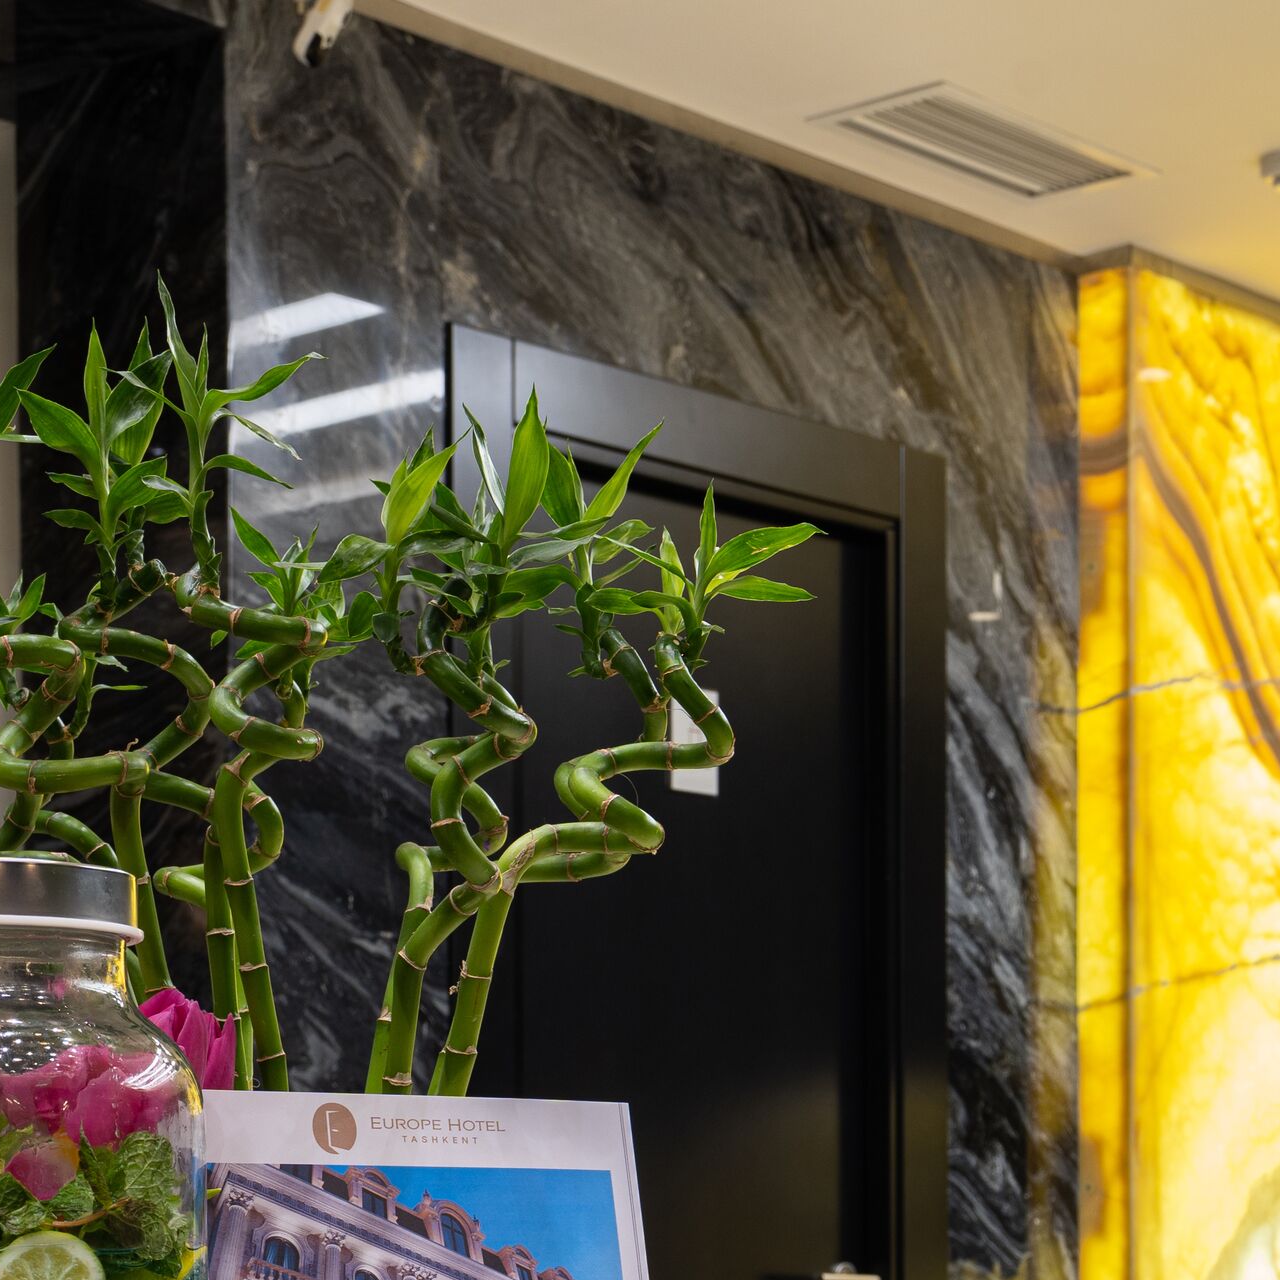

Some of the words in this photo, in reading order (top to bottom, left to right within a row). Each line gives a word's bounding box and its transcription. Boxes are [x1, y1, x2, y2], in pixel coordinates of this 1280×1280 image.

[371, 1116, 442, 1131] EUROPE
[448, 1118, 506, 1132] HOTEL
[402, 1135, 478, 1145] TASHKENT
